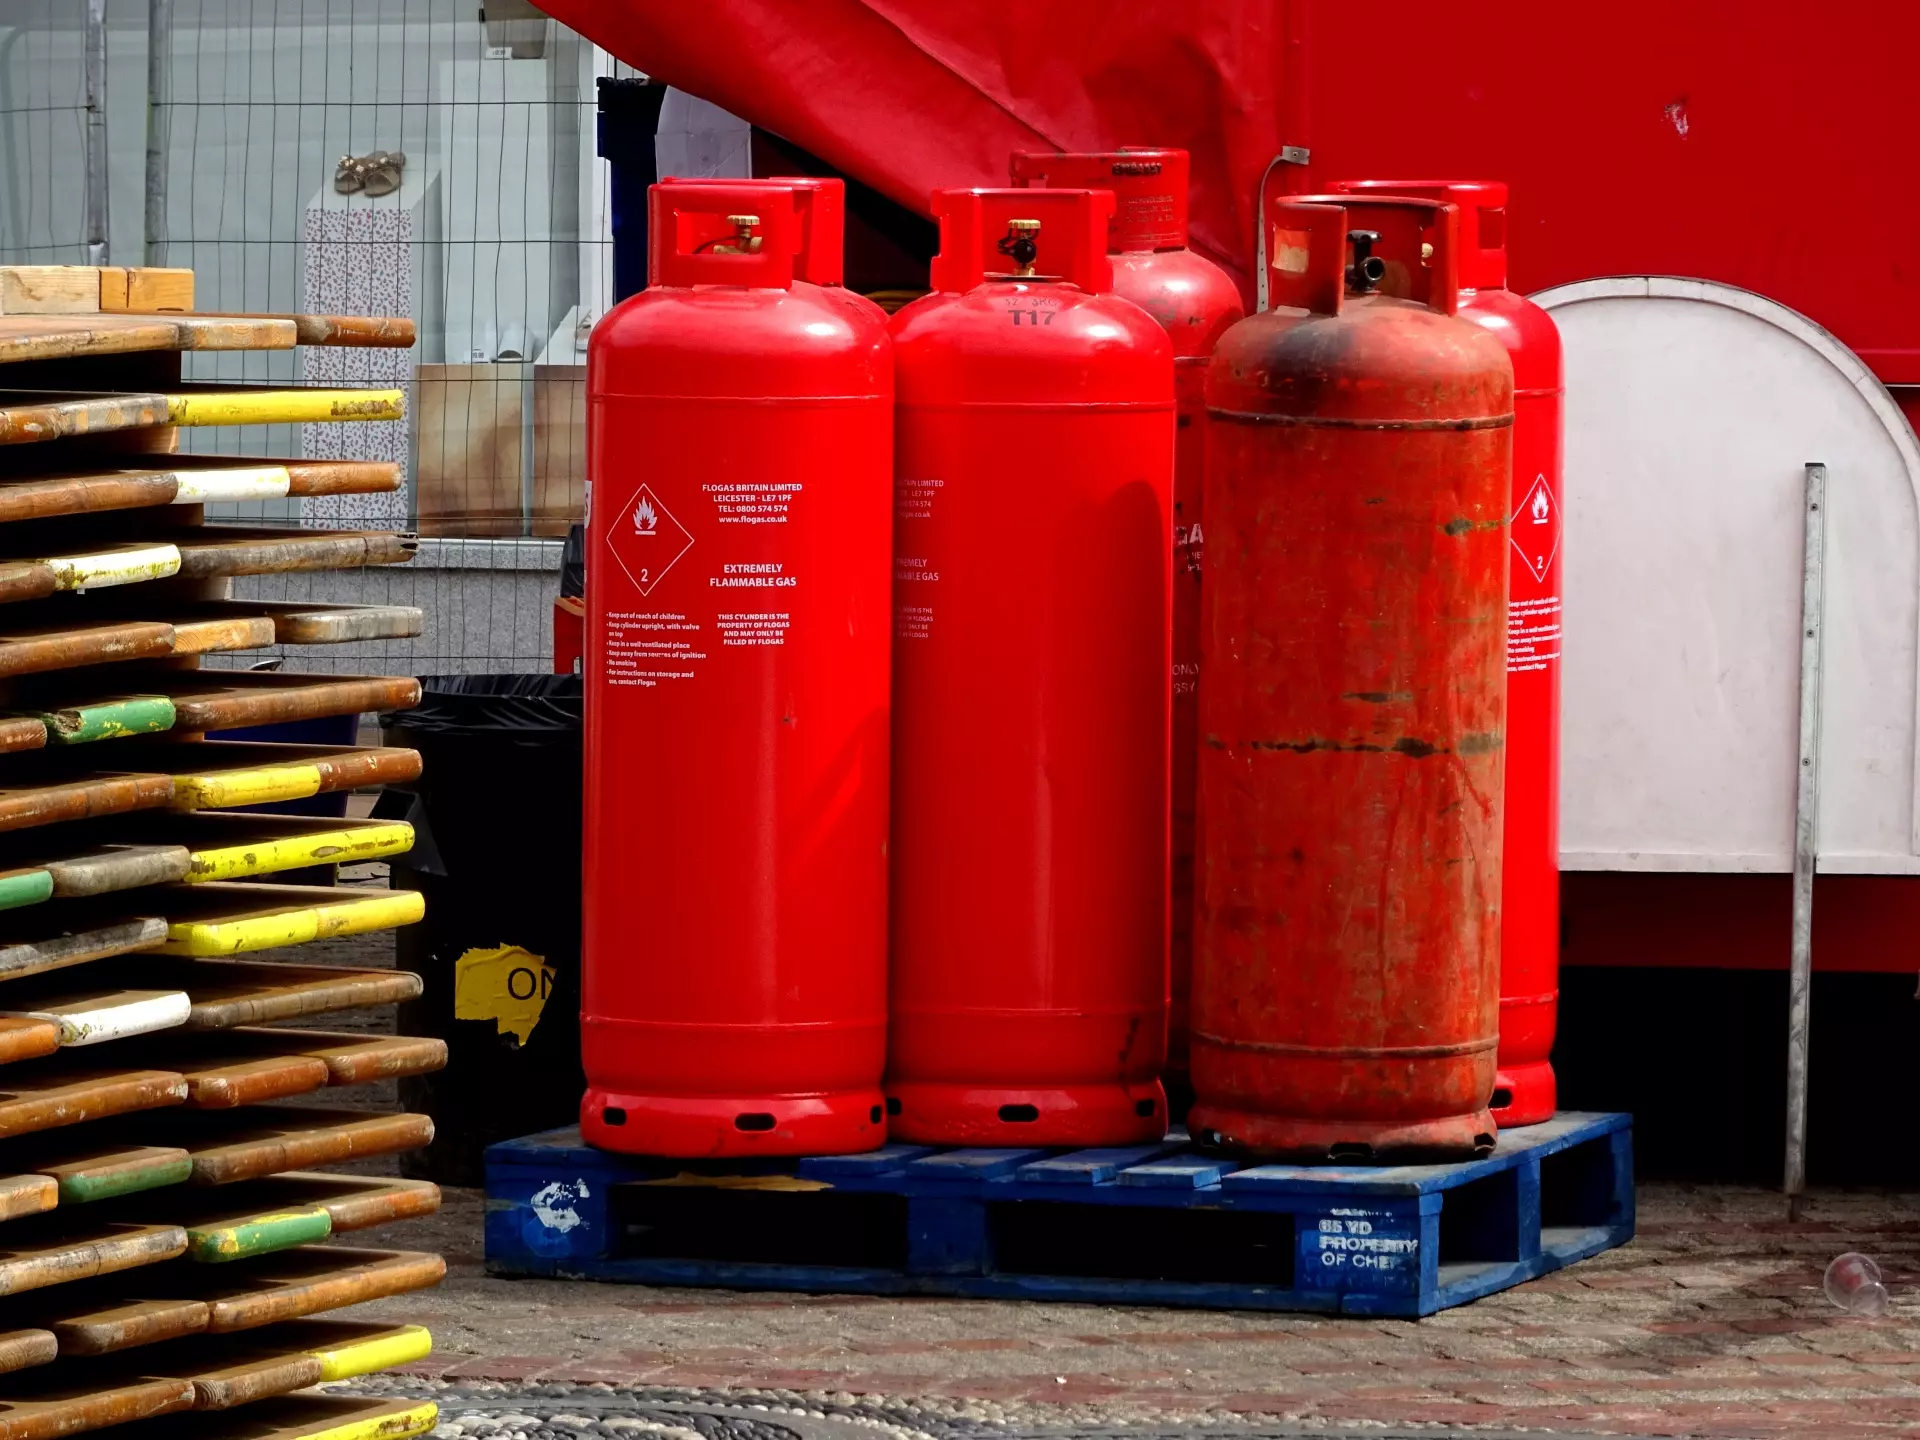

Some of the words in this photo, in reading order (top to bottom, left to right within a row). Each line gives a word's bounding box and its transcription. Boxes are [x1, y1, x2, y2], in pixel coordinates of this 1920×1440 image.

[1008, 310, 1056, 326] T17
[718, 515, 787, 524] www.flogas.co.uk
[724, 564, 782, 573] EXTREMELY
[1537, 556, 1543, 569] 2
[641, 568, 648, 582] 2
[922, 572, 939, 581] GAS
[710, 578, 774, 587] FLAMMABLE
[776, 577, 796, 586] GAS
[1345, 1220, 1372, 1235] YD
[1319, 1235, 1418, 1253] PROPERTY
[1321, 1252, 1346, 1266] OF
